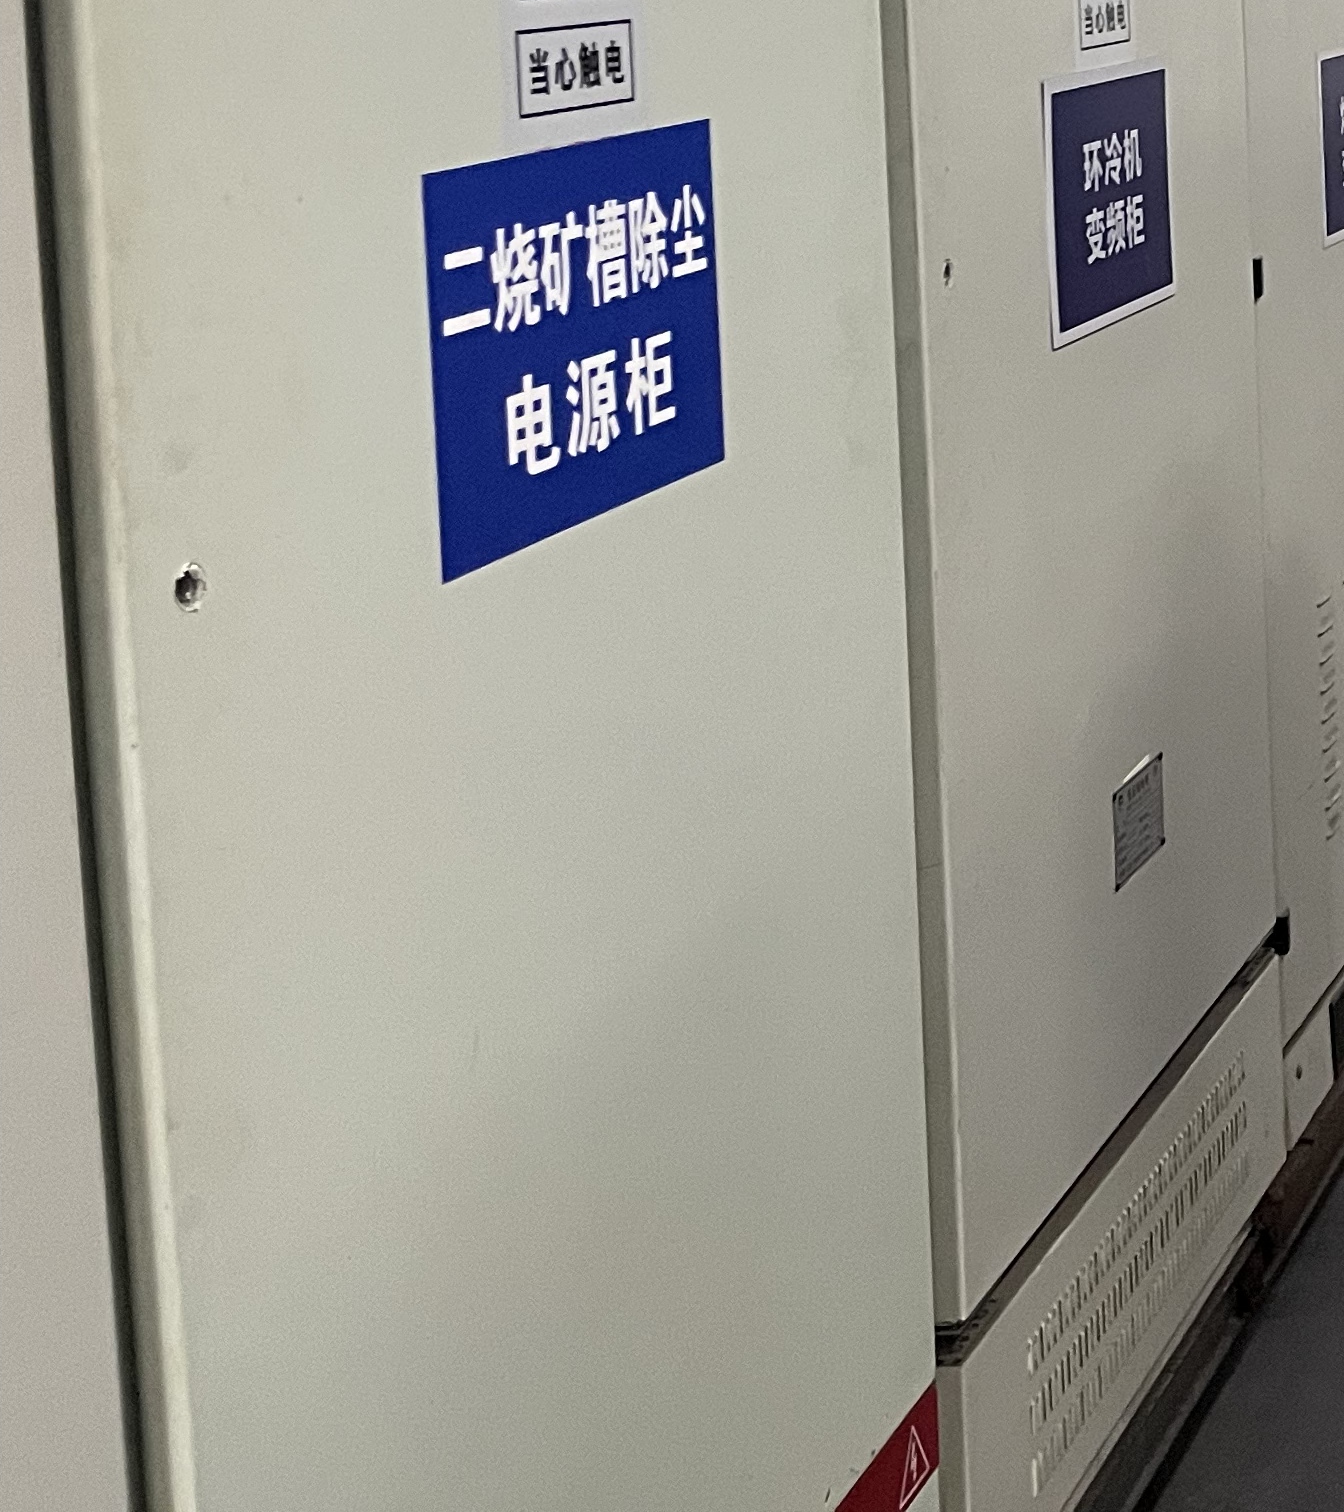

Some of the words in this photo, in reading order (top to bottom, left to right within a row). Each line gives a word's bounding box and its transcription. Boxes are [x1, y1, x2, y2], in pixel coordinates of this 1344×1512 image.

[529, 40, 625, 95] 当心触电
[1082, 128, 1143, 191] 环冷机
[441, 184, 708, 337] 二烧矿槽除尘
[1085, 194, 1146, 265] 变频柜
[506, 330, 676, 476] 电源柜
